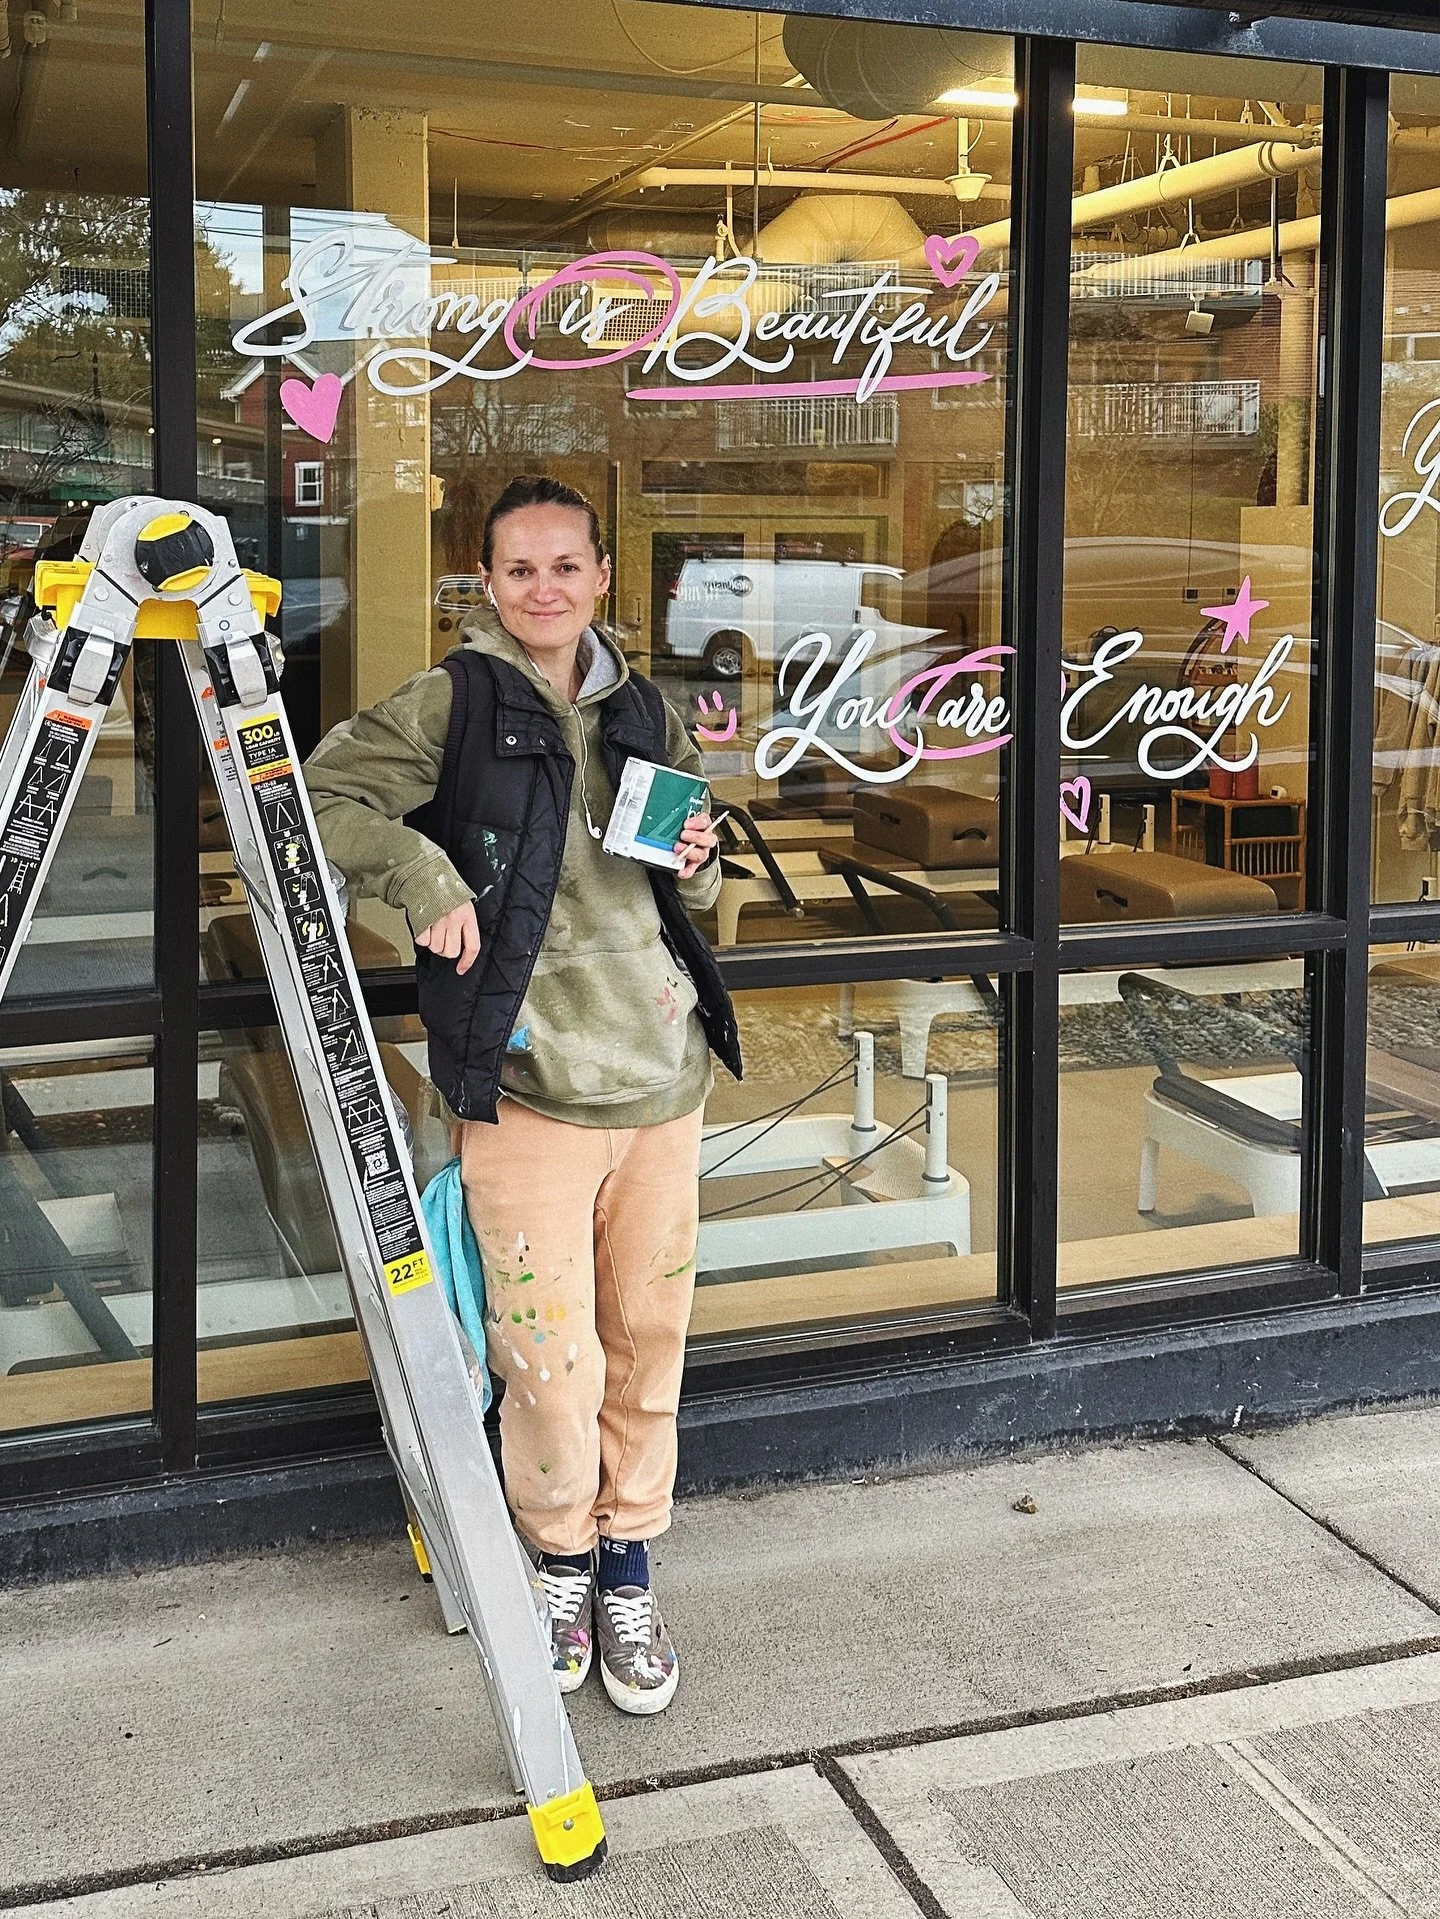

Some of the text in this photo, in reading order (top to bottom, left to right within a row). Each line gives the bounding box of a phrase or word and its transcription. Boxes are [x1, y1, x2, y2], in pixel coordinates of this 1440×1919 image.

[231, 230, 999, 404] Strong is Beautiful
[755, 629, 1296, 784] You are Enough
[242, 724, 274, 745] 300
[248, 749, 267, 760] TYPE
[390, 1263, 414, 1284] 22
[412, 1258, 424, 1268] FT
